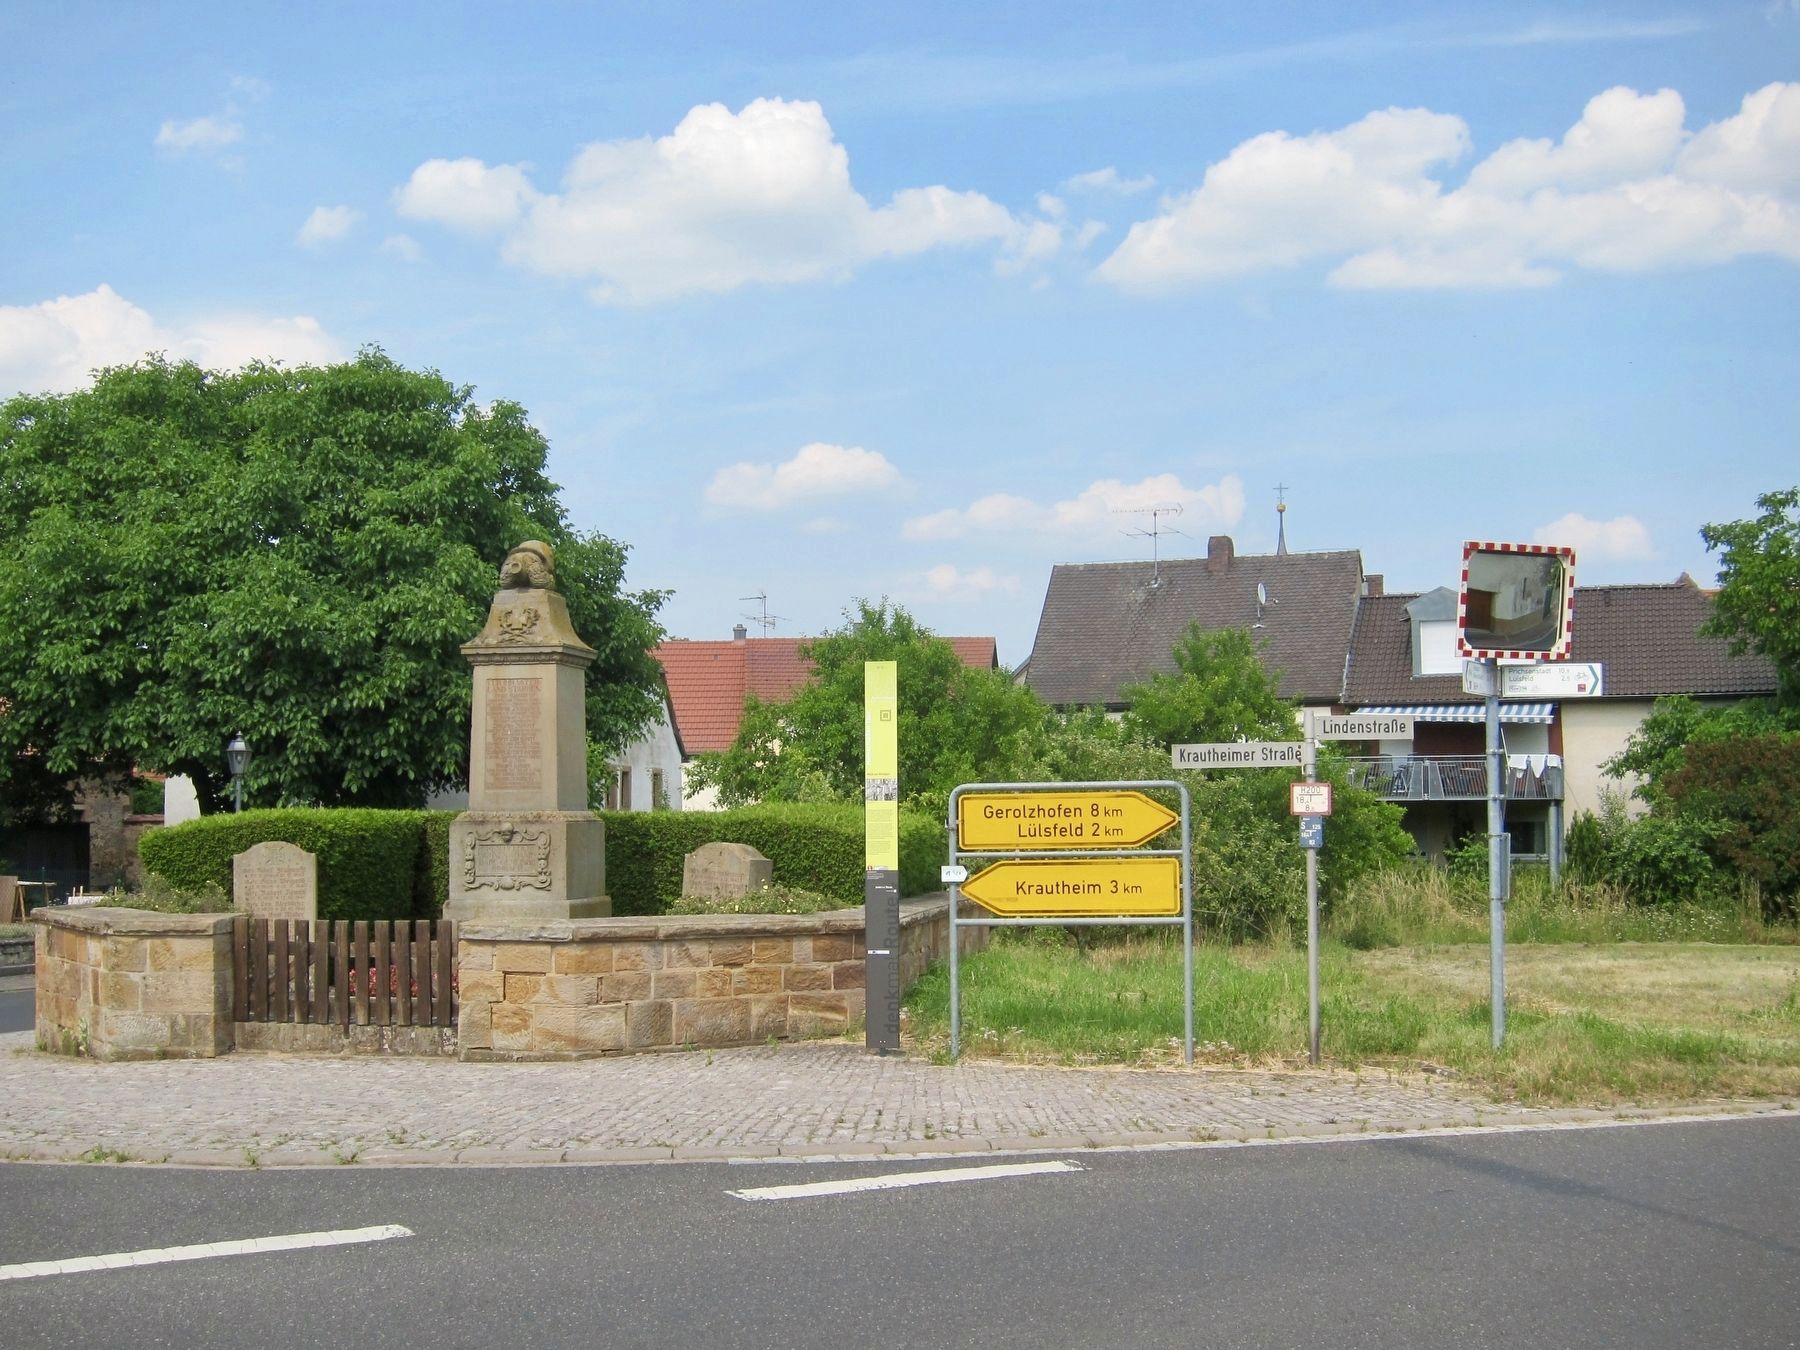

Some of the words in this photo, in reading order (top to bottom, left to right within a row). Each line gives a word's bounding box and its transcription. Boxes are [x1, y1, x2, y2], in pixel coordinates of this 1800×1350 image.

[1323, 719, 1406, 734] Lindenstraße
[1179, 748, 1256, 763] Krautheimer
[1261, 747, 1302, 761] Straße
[983, 804, 1082, 819] Gerolzhofen
[1090, 803, 1100, 817] 8
[1104, 806, 1123, 817] km
[1018, 822, 1083, 838] Lülsfeld
[1091, 823, 1100, 837] 2
[1104, 825, 1123, 837] km
[1016, 879, 1101, 895] Krautheim
[1110, 879, 1119, 894] 3
[1123, 882, 1142, 894] km
